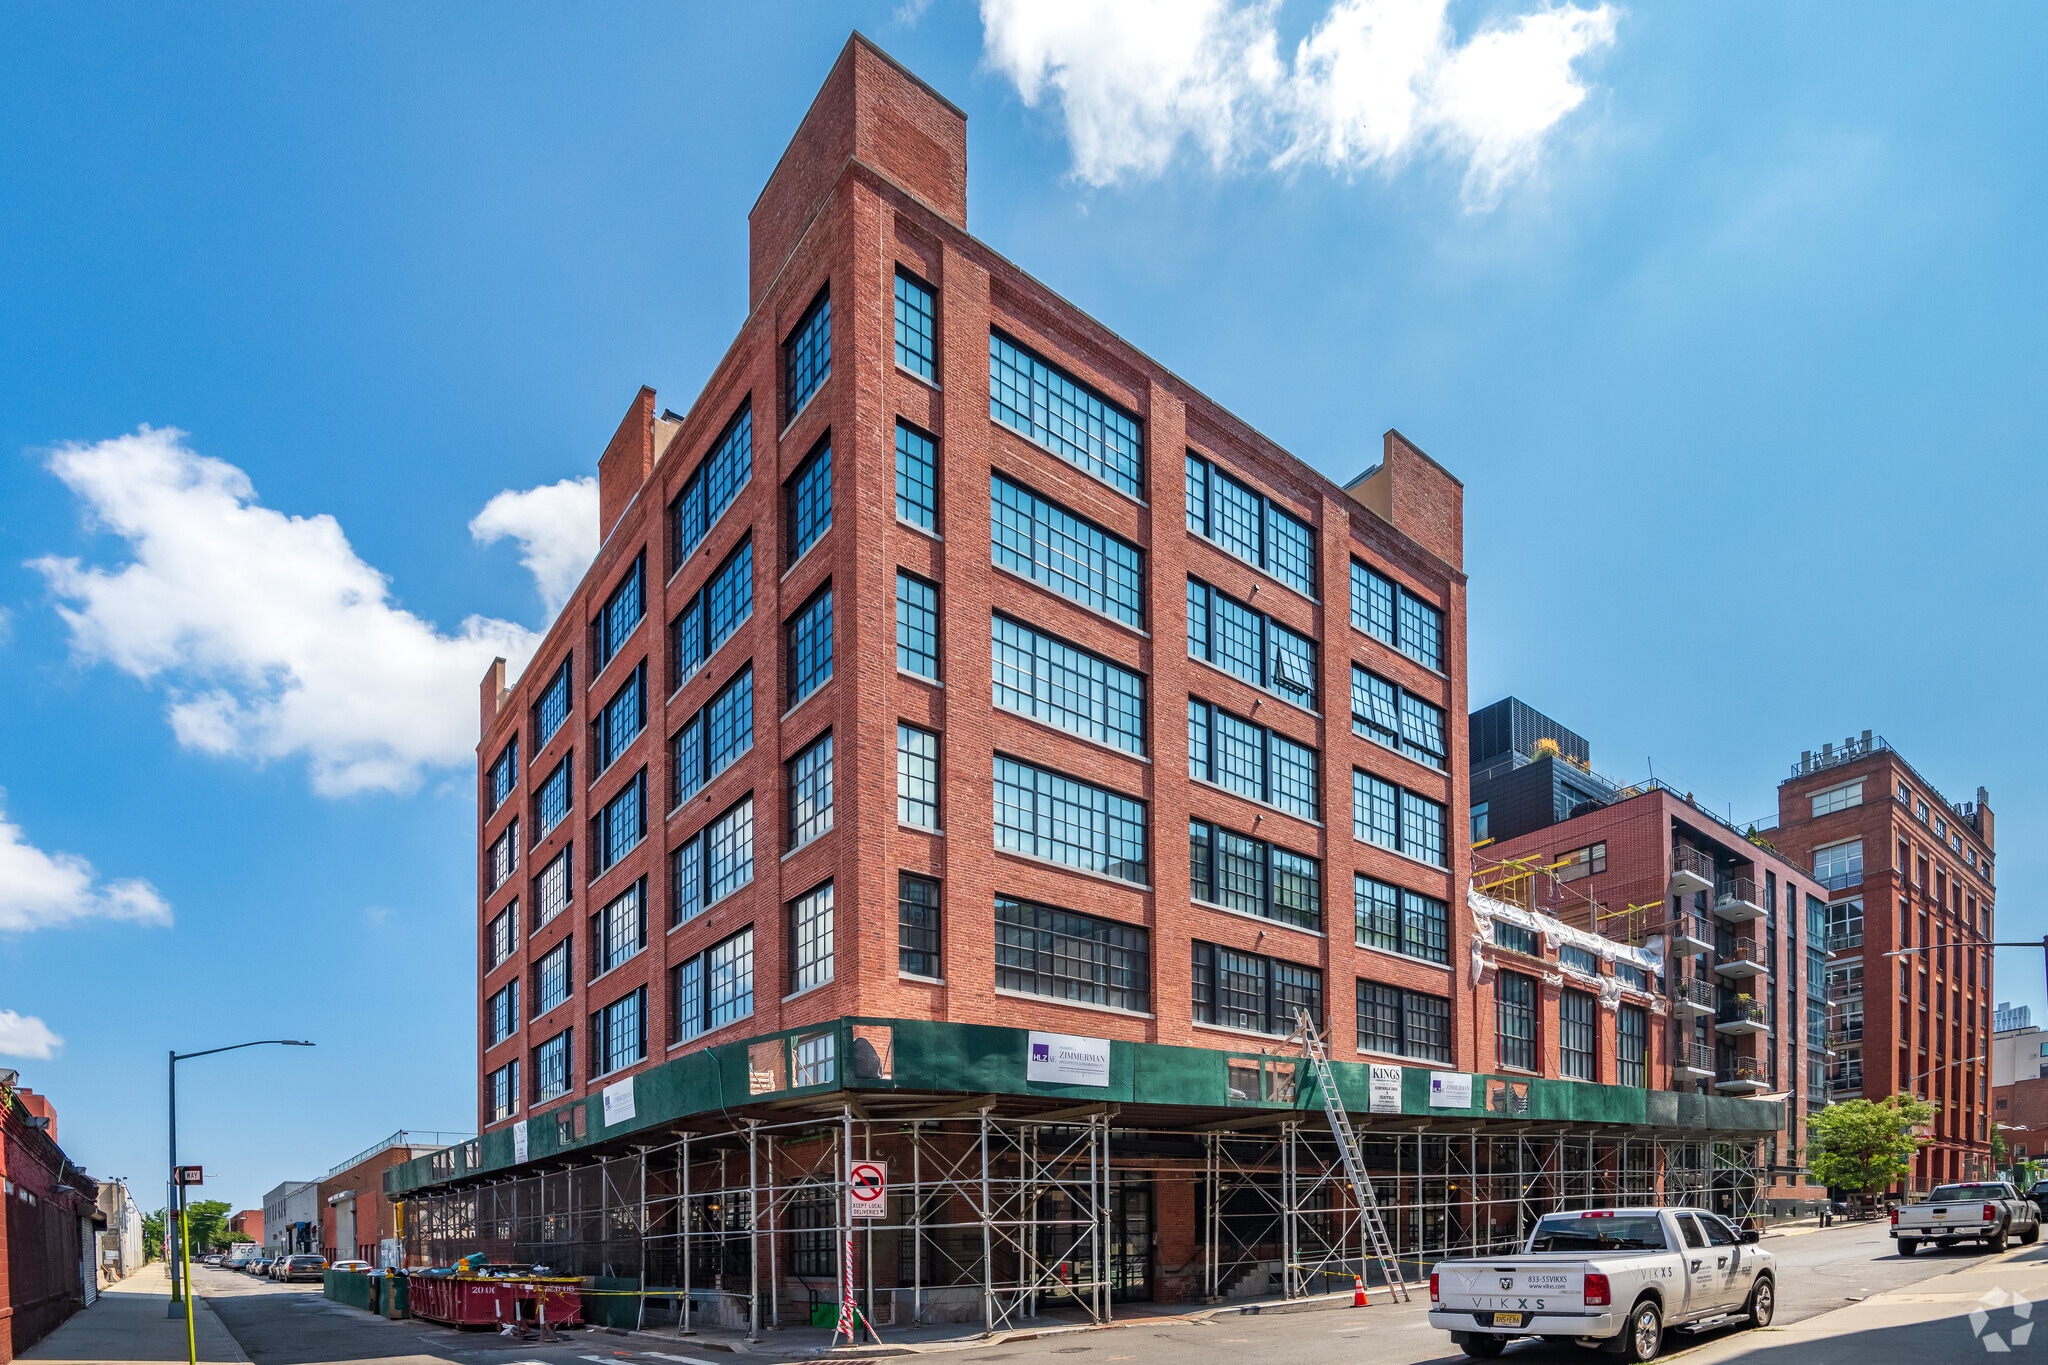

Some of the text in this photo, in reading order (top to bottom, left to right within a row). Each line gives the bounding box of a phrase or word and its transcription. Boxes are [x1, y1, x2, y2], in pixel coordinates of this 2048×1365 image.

[1033, 1054, 1048, 1062] HLZ
[1059, 1051, 1105, 1063] ZIMMERMAN
[1373, 1067, 1400, 1081] KINGS
[1528, 1275, 1568, 1283] 833-55VIKXS
[1472, 1297, 1545, 1310] VIKXS
